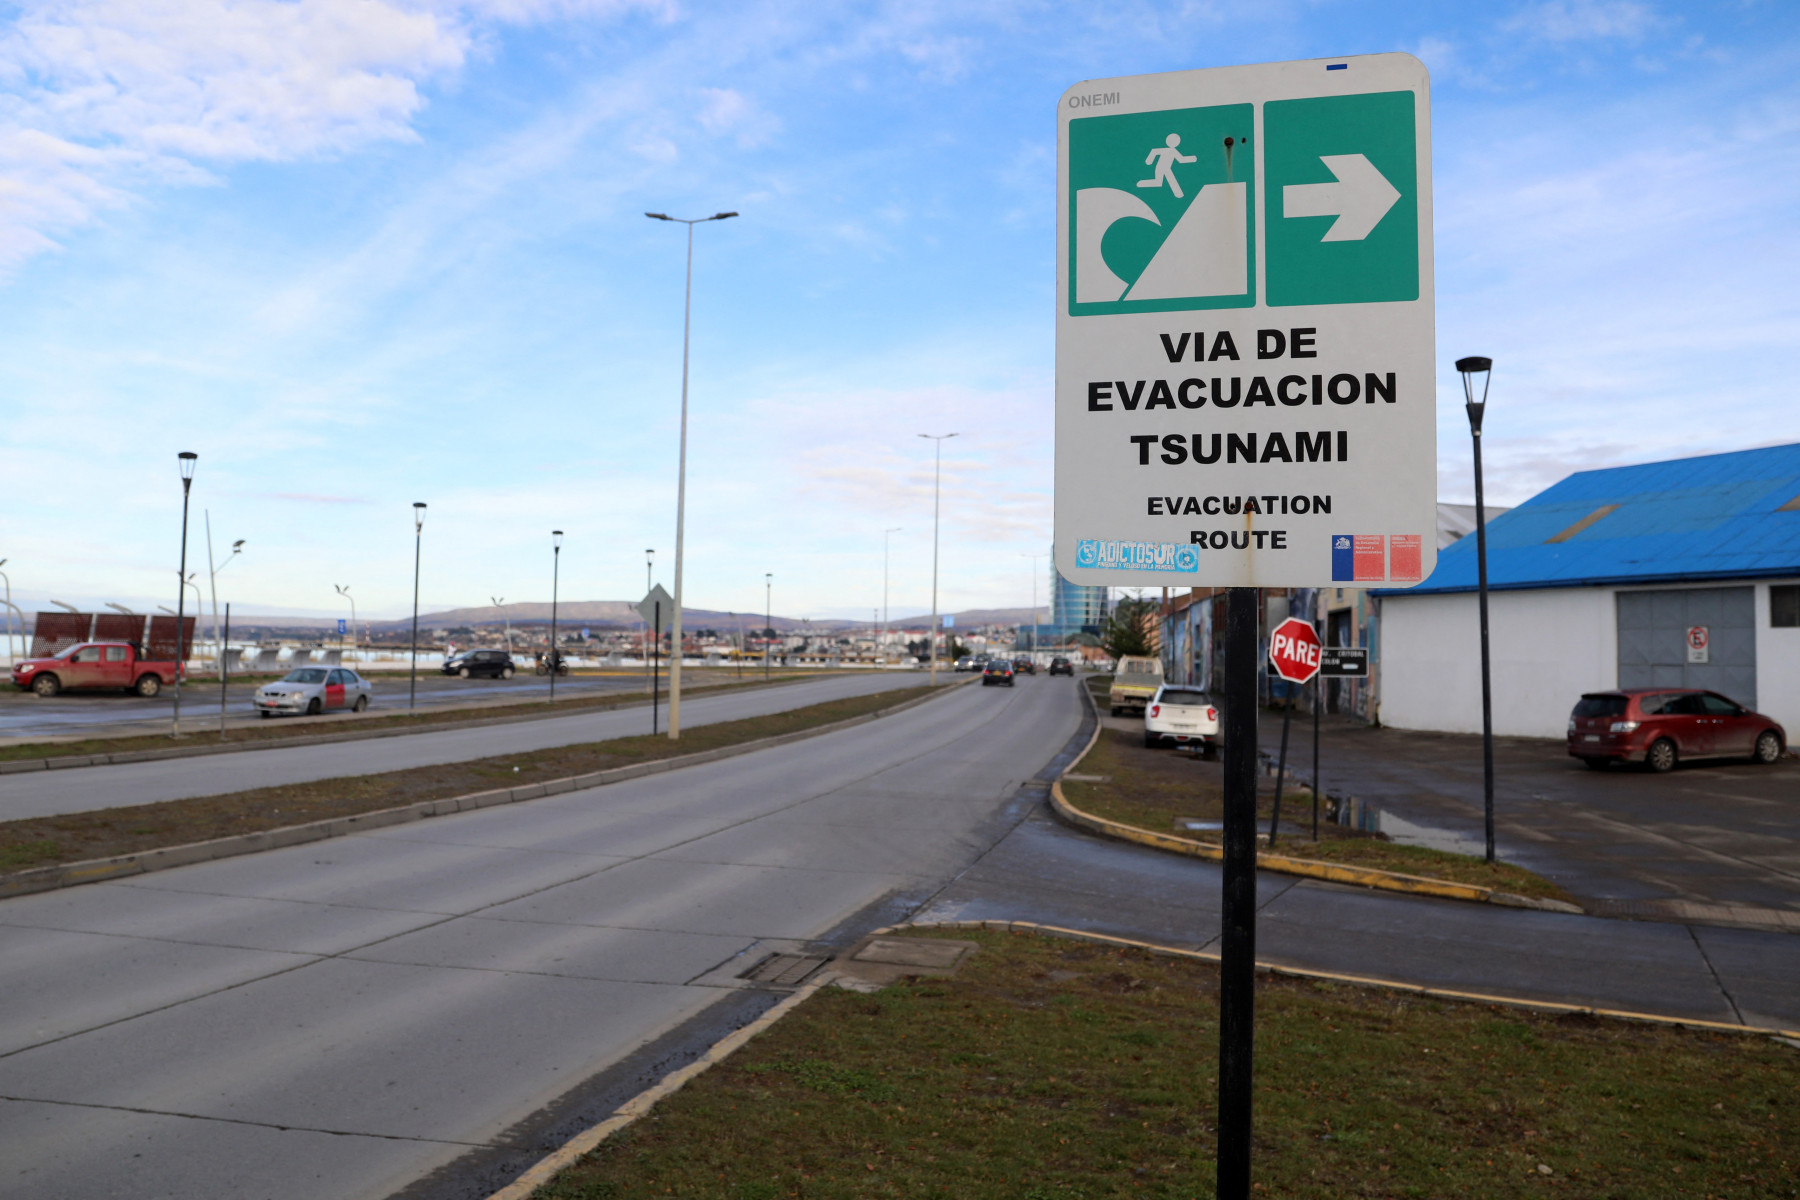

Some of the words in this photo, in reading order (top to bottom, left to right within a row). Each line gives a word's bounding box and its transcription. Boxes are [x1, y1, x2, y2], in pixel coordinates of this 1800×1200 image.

[1068, 92, 1120, 109] ONEMI
[1159, 331, 1240, 363] VIA
[1257, 327, 1318, 360] DE
[1087, 372, 1397, 412] EVACUACION
[1130, 430, 1348, 466] TSUNAMI
[1147, 494, 1332, 516] EVACUATION
[1097, 541, 1175, 565] ADICTOSUR
[1190, 530, 1287, 550] ROUTE
[1273, 634, 1319, 668] PARE
